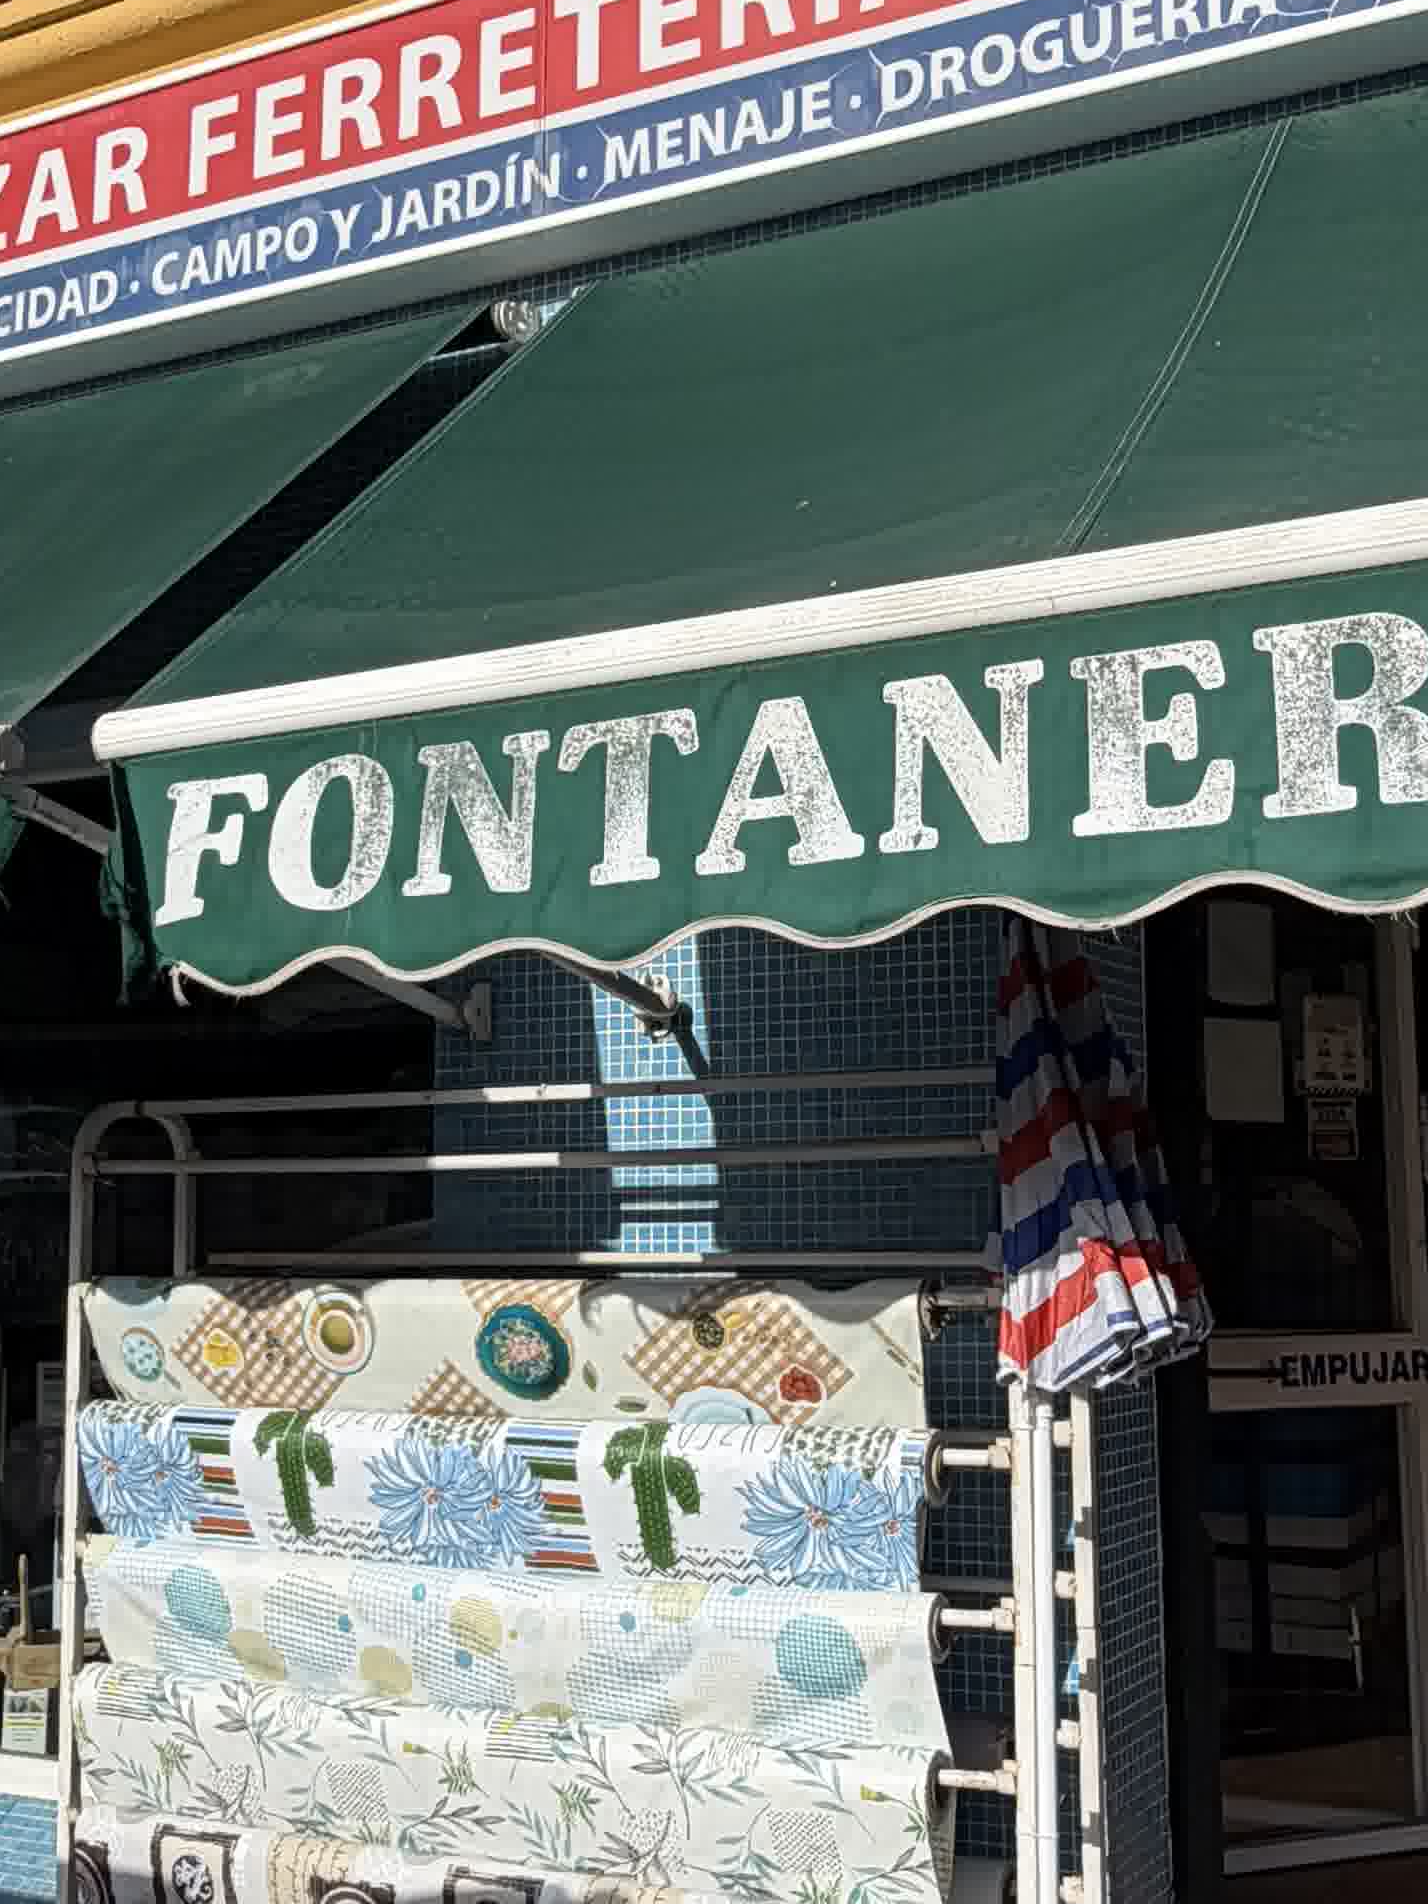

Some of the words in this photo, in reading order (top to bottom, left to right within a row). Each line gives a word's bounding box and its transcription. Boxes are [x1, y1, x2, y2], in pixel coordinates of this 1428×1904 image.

[152, 218, 318, 296] CAMPO
[330, 204, 364, 253] Y
[372, 151, 561, 242] JARDÍN
[604, 89, 832, 182] MENAJE
